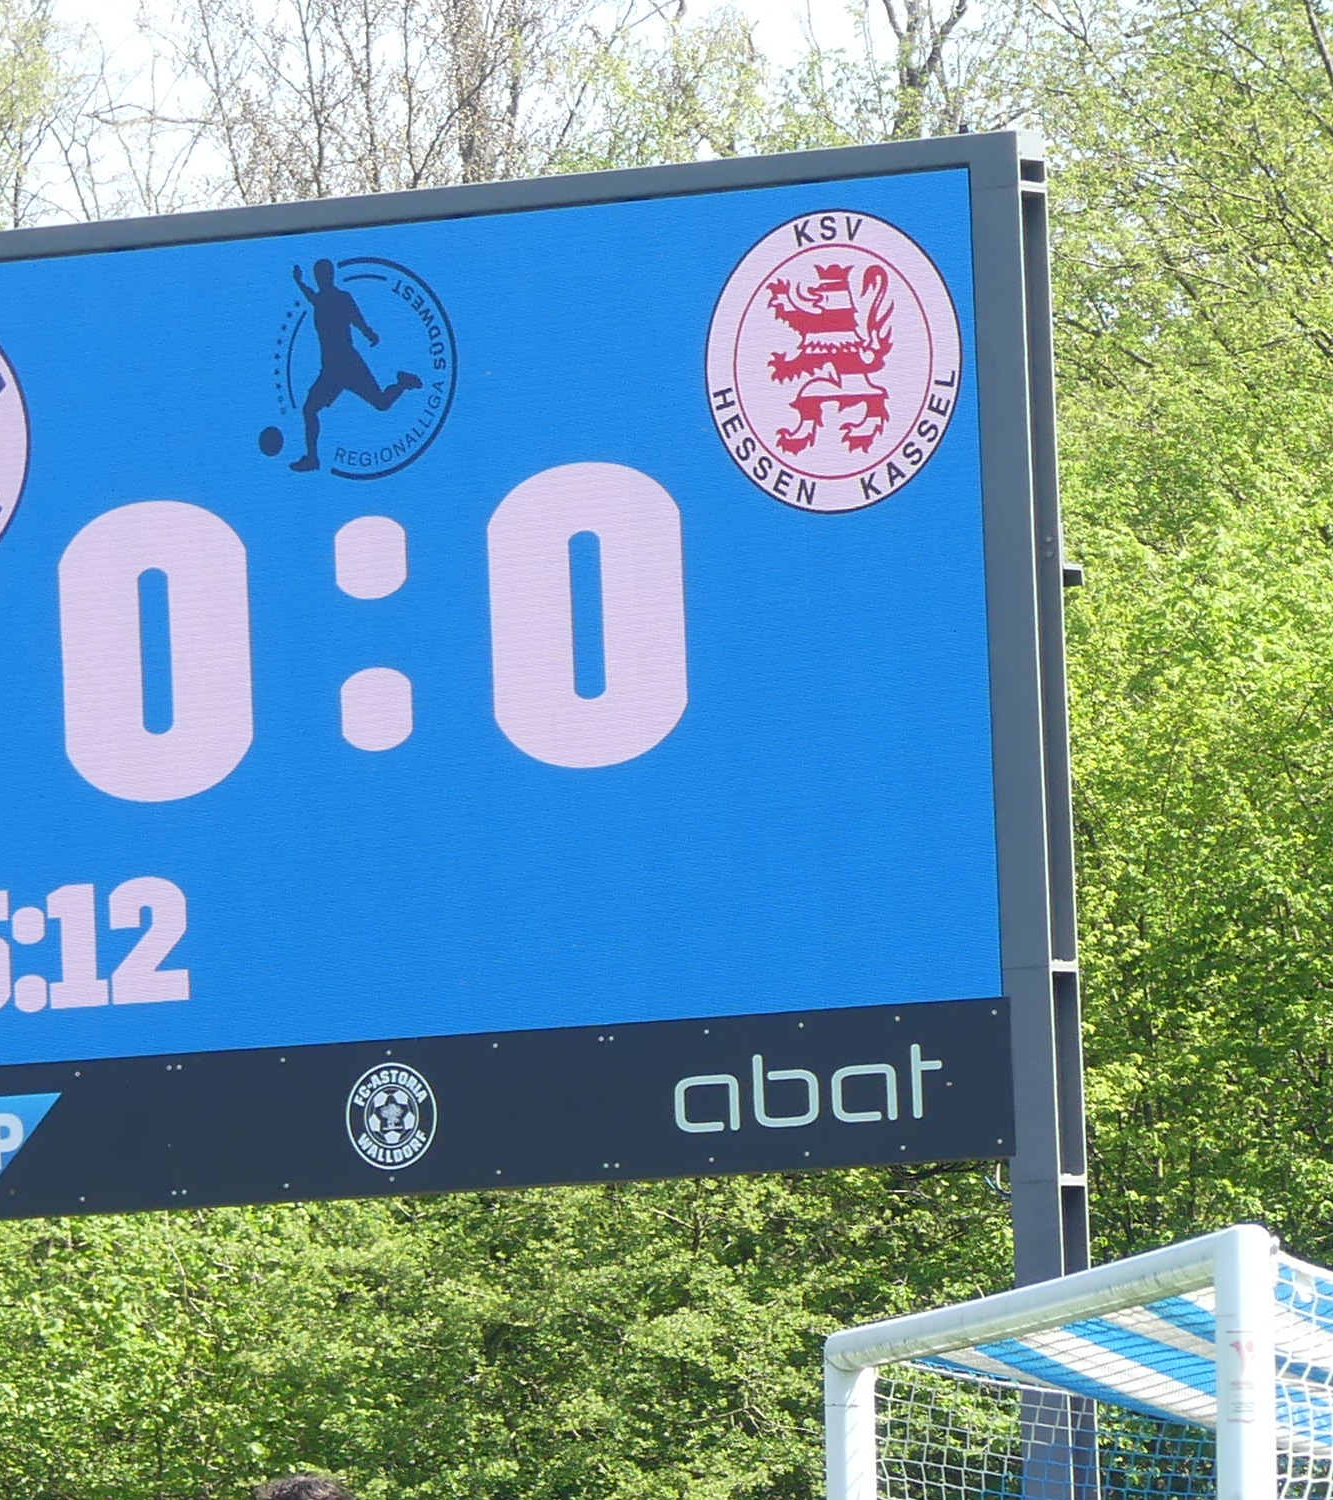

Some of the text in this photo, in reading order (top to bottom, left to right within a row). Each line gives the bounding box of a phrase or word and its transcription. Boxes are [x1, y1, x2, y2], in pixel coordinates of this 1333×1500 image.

[793, 216, 863, 247] KSV
[334, 279, 447, 467] REGIONALLIGA SÜDWEST
[713, 370, 956, 505] HESSEN KASSEL
[353, 1069, 428, 1107] FC-ASTORIA
[674, 1043, 943, 1134] abat
[358, 1129, 427, 1163] WALLDORF
